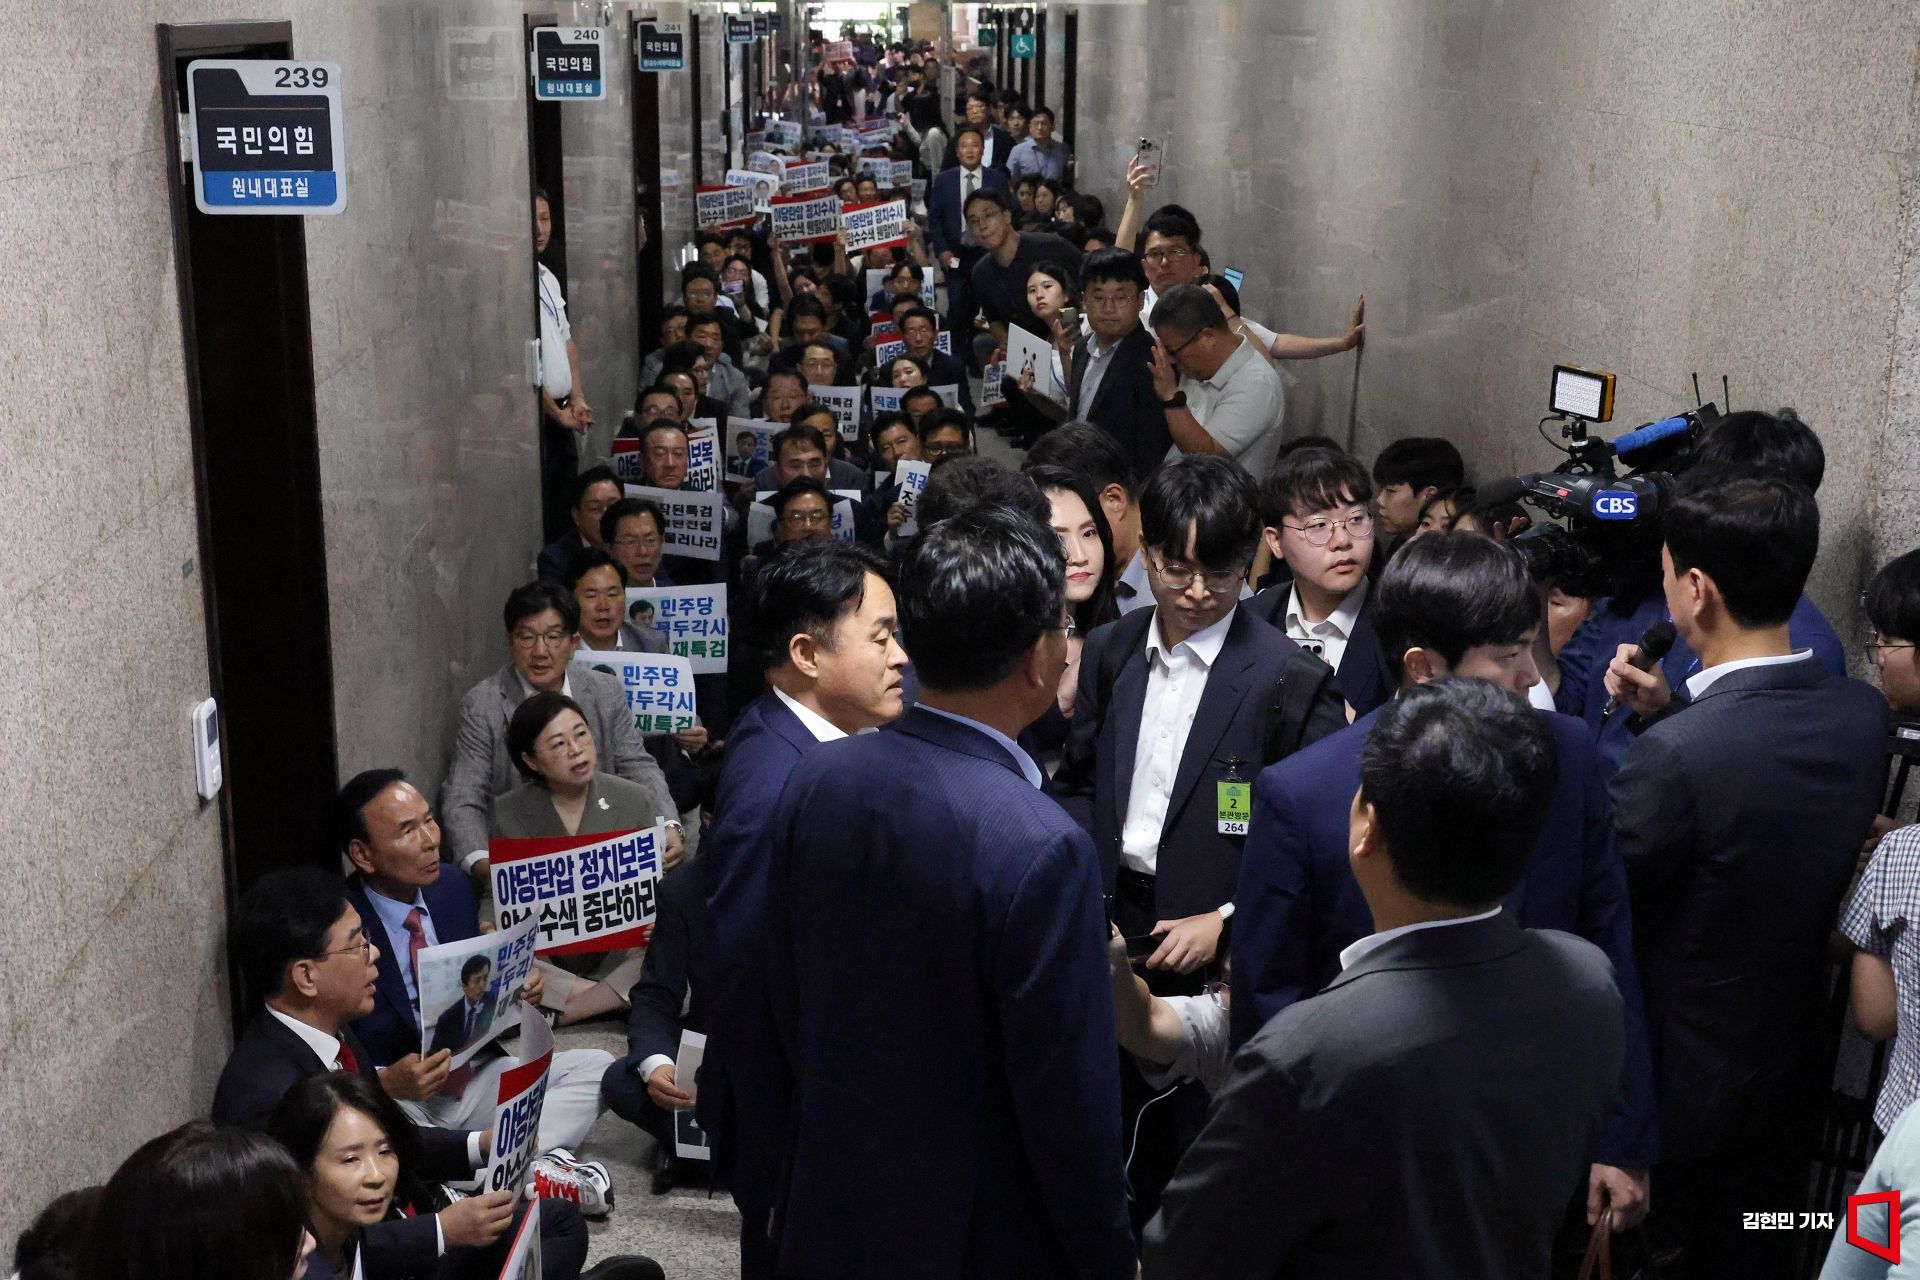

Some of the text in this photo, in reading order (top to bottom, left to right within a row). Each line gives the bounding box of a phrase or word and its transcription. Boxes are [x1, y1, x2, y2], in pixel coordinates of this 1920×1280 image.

[574, 29, 599, 41] 240
[664, 24, 681, 32] 241
[646, 41, 678, 53] 국민의힘
[546, 56, 592, 72] 국민의힘
[274, 67, 329, 88] 239
[546, 82, 593, 94] 원내대표실
[216, 125, 314, 155] 국민의힘
[232, 177, 309, 198] 원내대표실
[774, 199, 836, 222] 야당탄압 정치수사
[845, 203, 903, 230] 야당탄압 정치수사
[775, 221, 805, 238] 압수수색
[1595, 497, 1635, 514] CBS
[660, 596, 714, 618] 민주당
[672, 639, 726, 659] 재특검
[623, 665, 680, 687] 민주당
[1230, 798, 1237, 809] 2
[1219, 810, 1249, 821] 본관방문
[1224, 822, 1244, 833] 264
[496, 832, 657, 907] 야당탄압 정치보복
